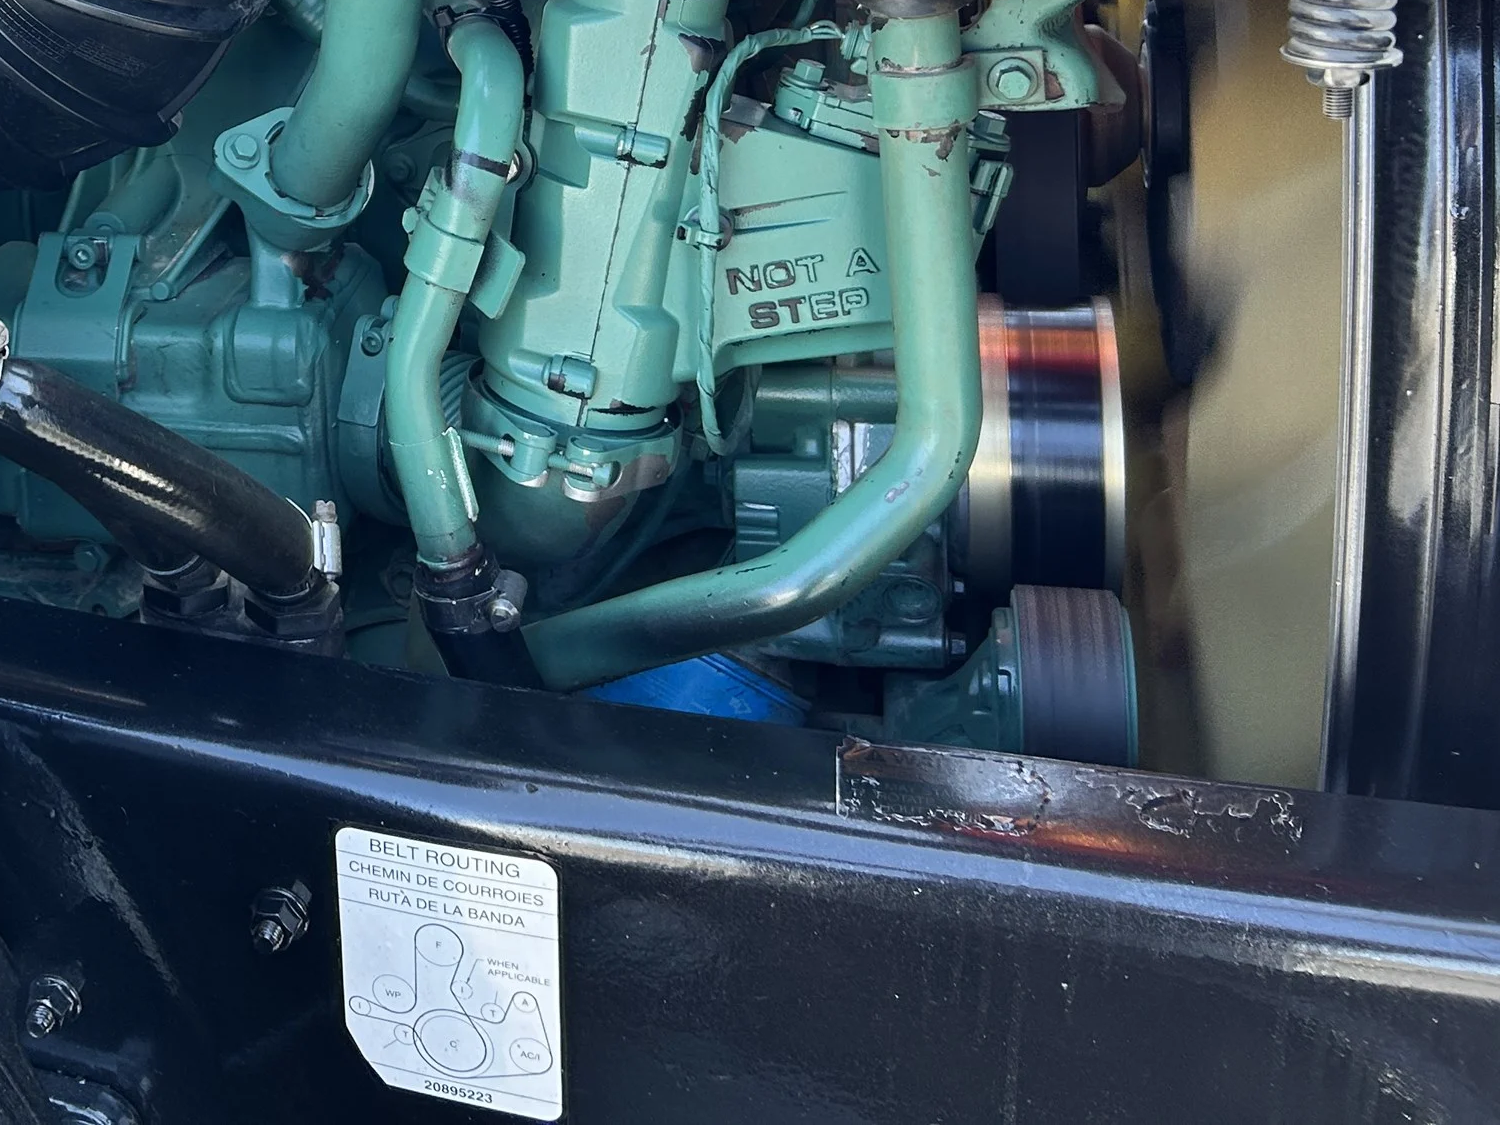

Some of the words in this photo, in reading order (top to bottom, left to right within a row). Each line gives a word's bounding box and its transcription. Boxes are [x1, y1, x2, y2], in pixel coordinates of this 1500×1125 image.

[726, 254, 824, 295] NOT
[846, 247, 882, 278] A
[748, 286, 870, 330] STEP
[369, 838, 419, 861] BELT
[426, 849, 521, 879] ROUTING
[349, 860, 411, 884] CHEMIN
[416, 873, 438, 888] DE
[443, 879, 544, 907] COURROIES
[416, 897, 438, 913] DE
[443, 903, 463, 918] LA
[468, 908, 525, 928] BANDA
[435, 941, 443, 950] F
[487, 958, 520, 971] WHEN
[487, 968, 552, 988] APPLICABLE
[385, 988, 402, 999] WP
[521, 998, 530, 1007] A
[489, 1010, 498, 1019] T
[402, 1031, 410, 1039] T
[424, 1080, 494, 1105] 20895223
